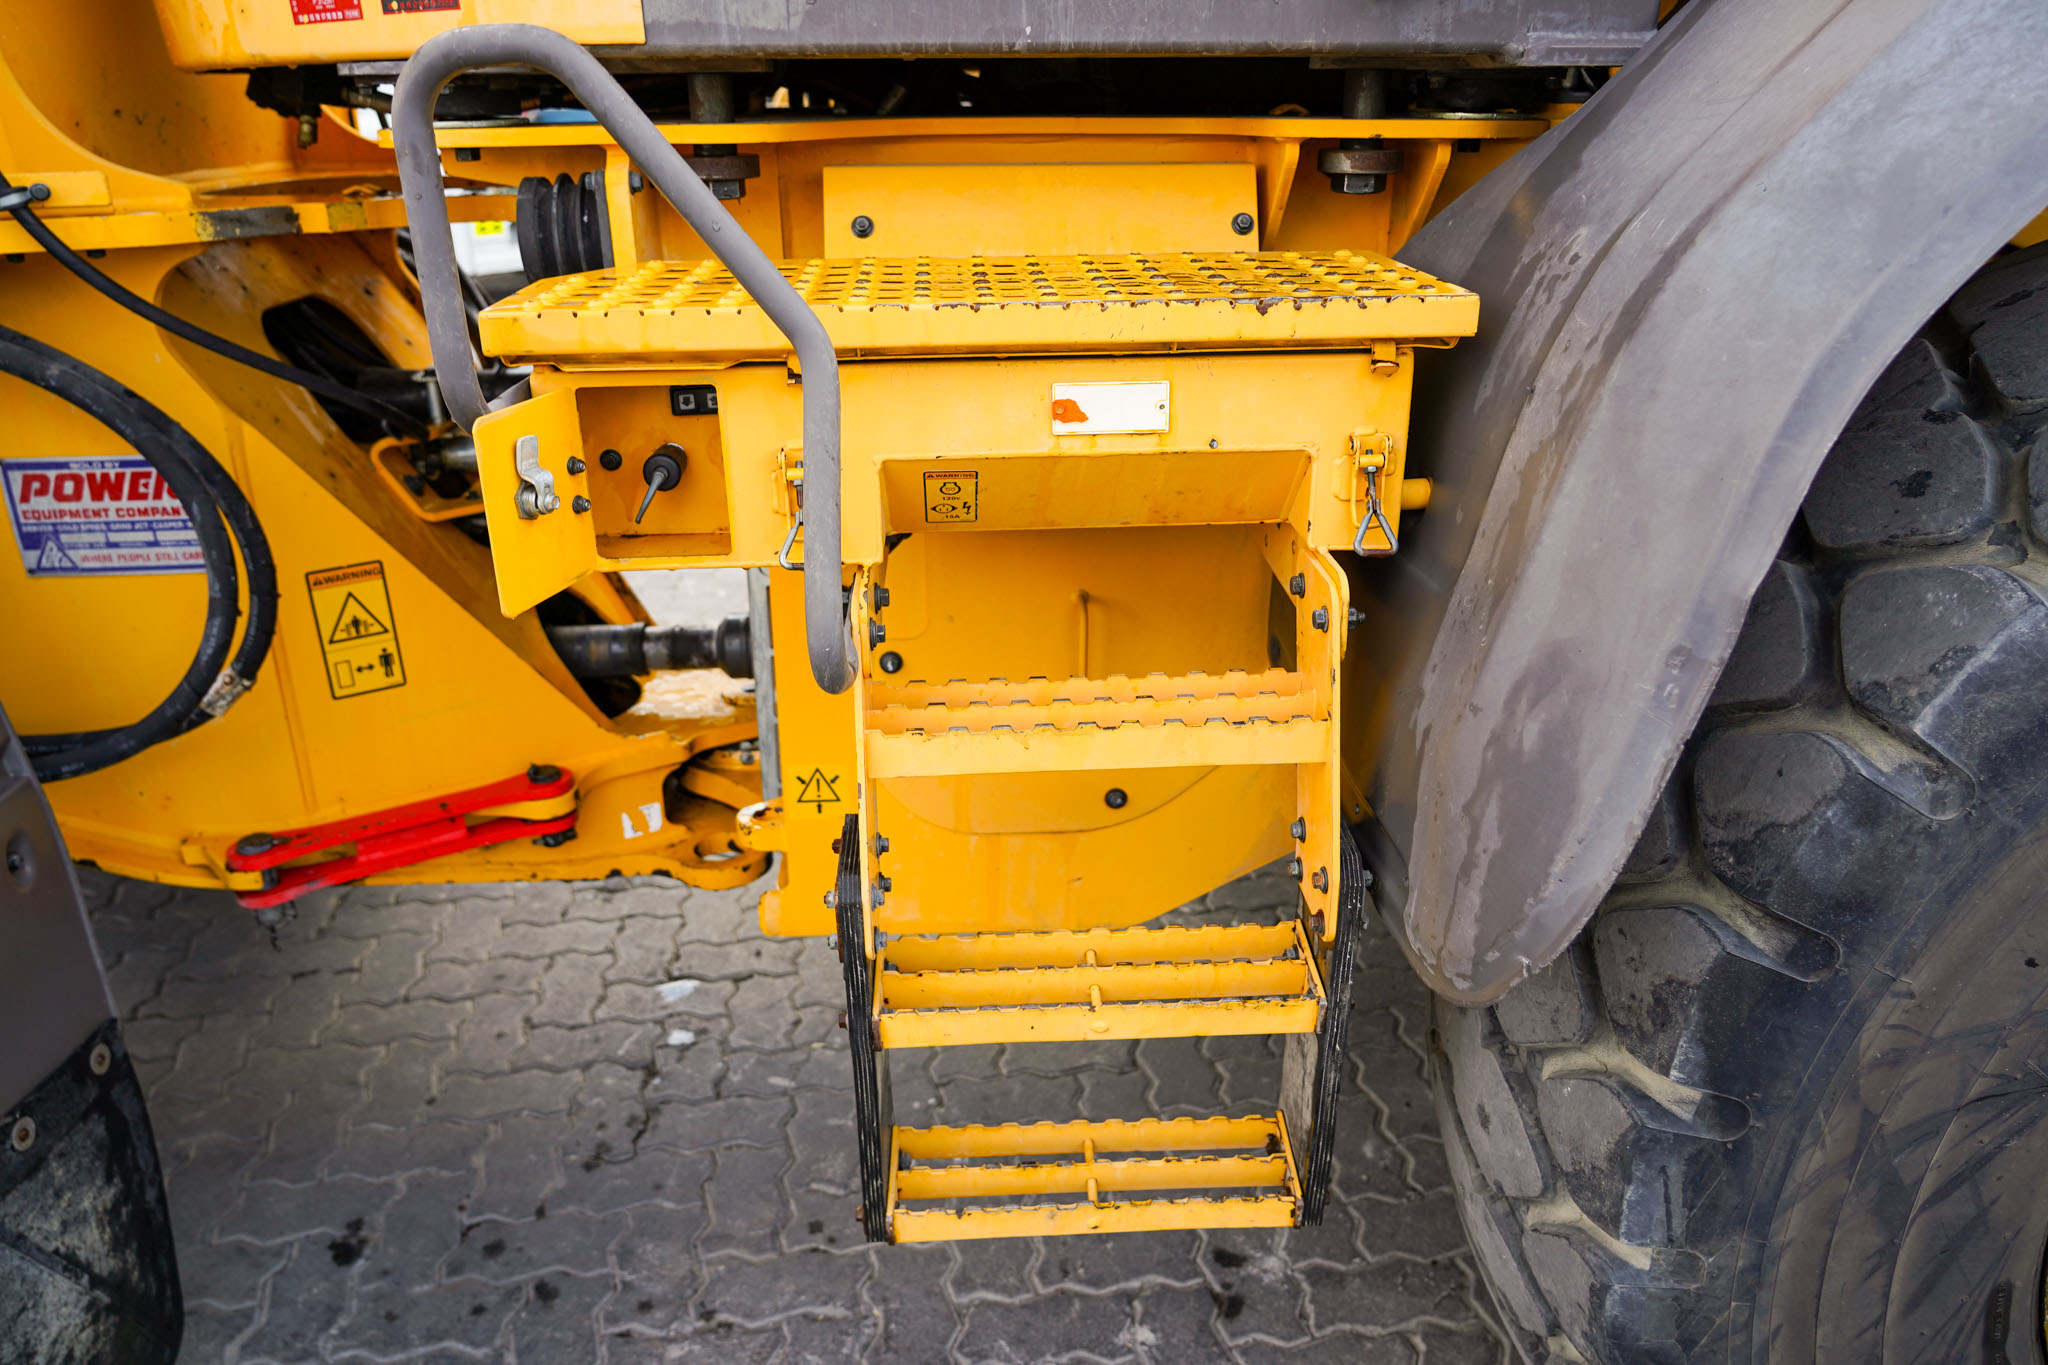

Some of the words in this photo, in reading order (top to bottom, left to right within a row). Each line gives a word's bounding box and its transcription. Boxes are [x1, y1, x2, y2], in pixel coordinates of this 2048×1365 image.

[21, 508, 110, 521] EQUIPMENT
[115, 506, 188, 518] COMPAN
[81, 554, 113, 563] WHERE
[117, 553, 151, 562] PEOPLE
[155, 552, 179, 560] STILL
[322, 567, 382, 584] WARNING
